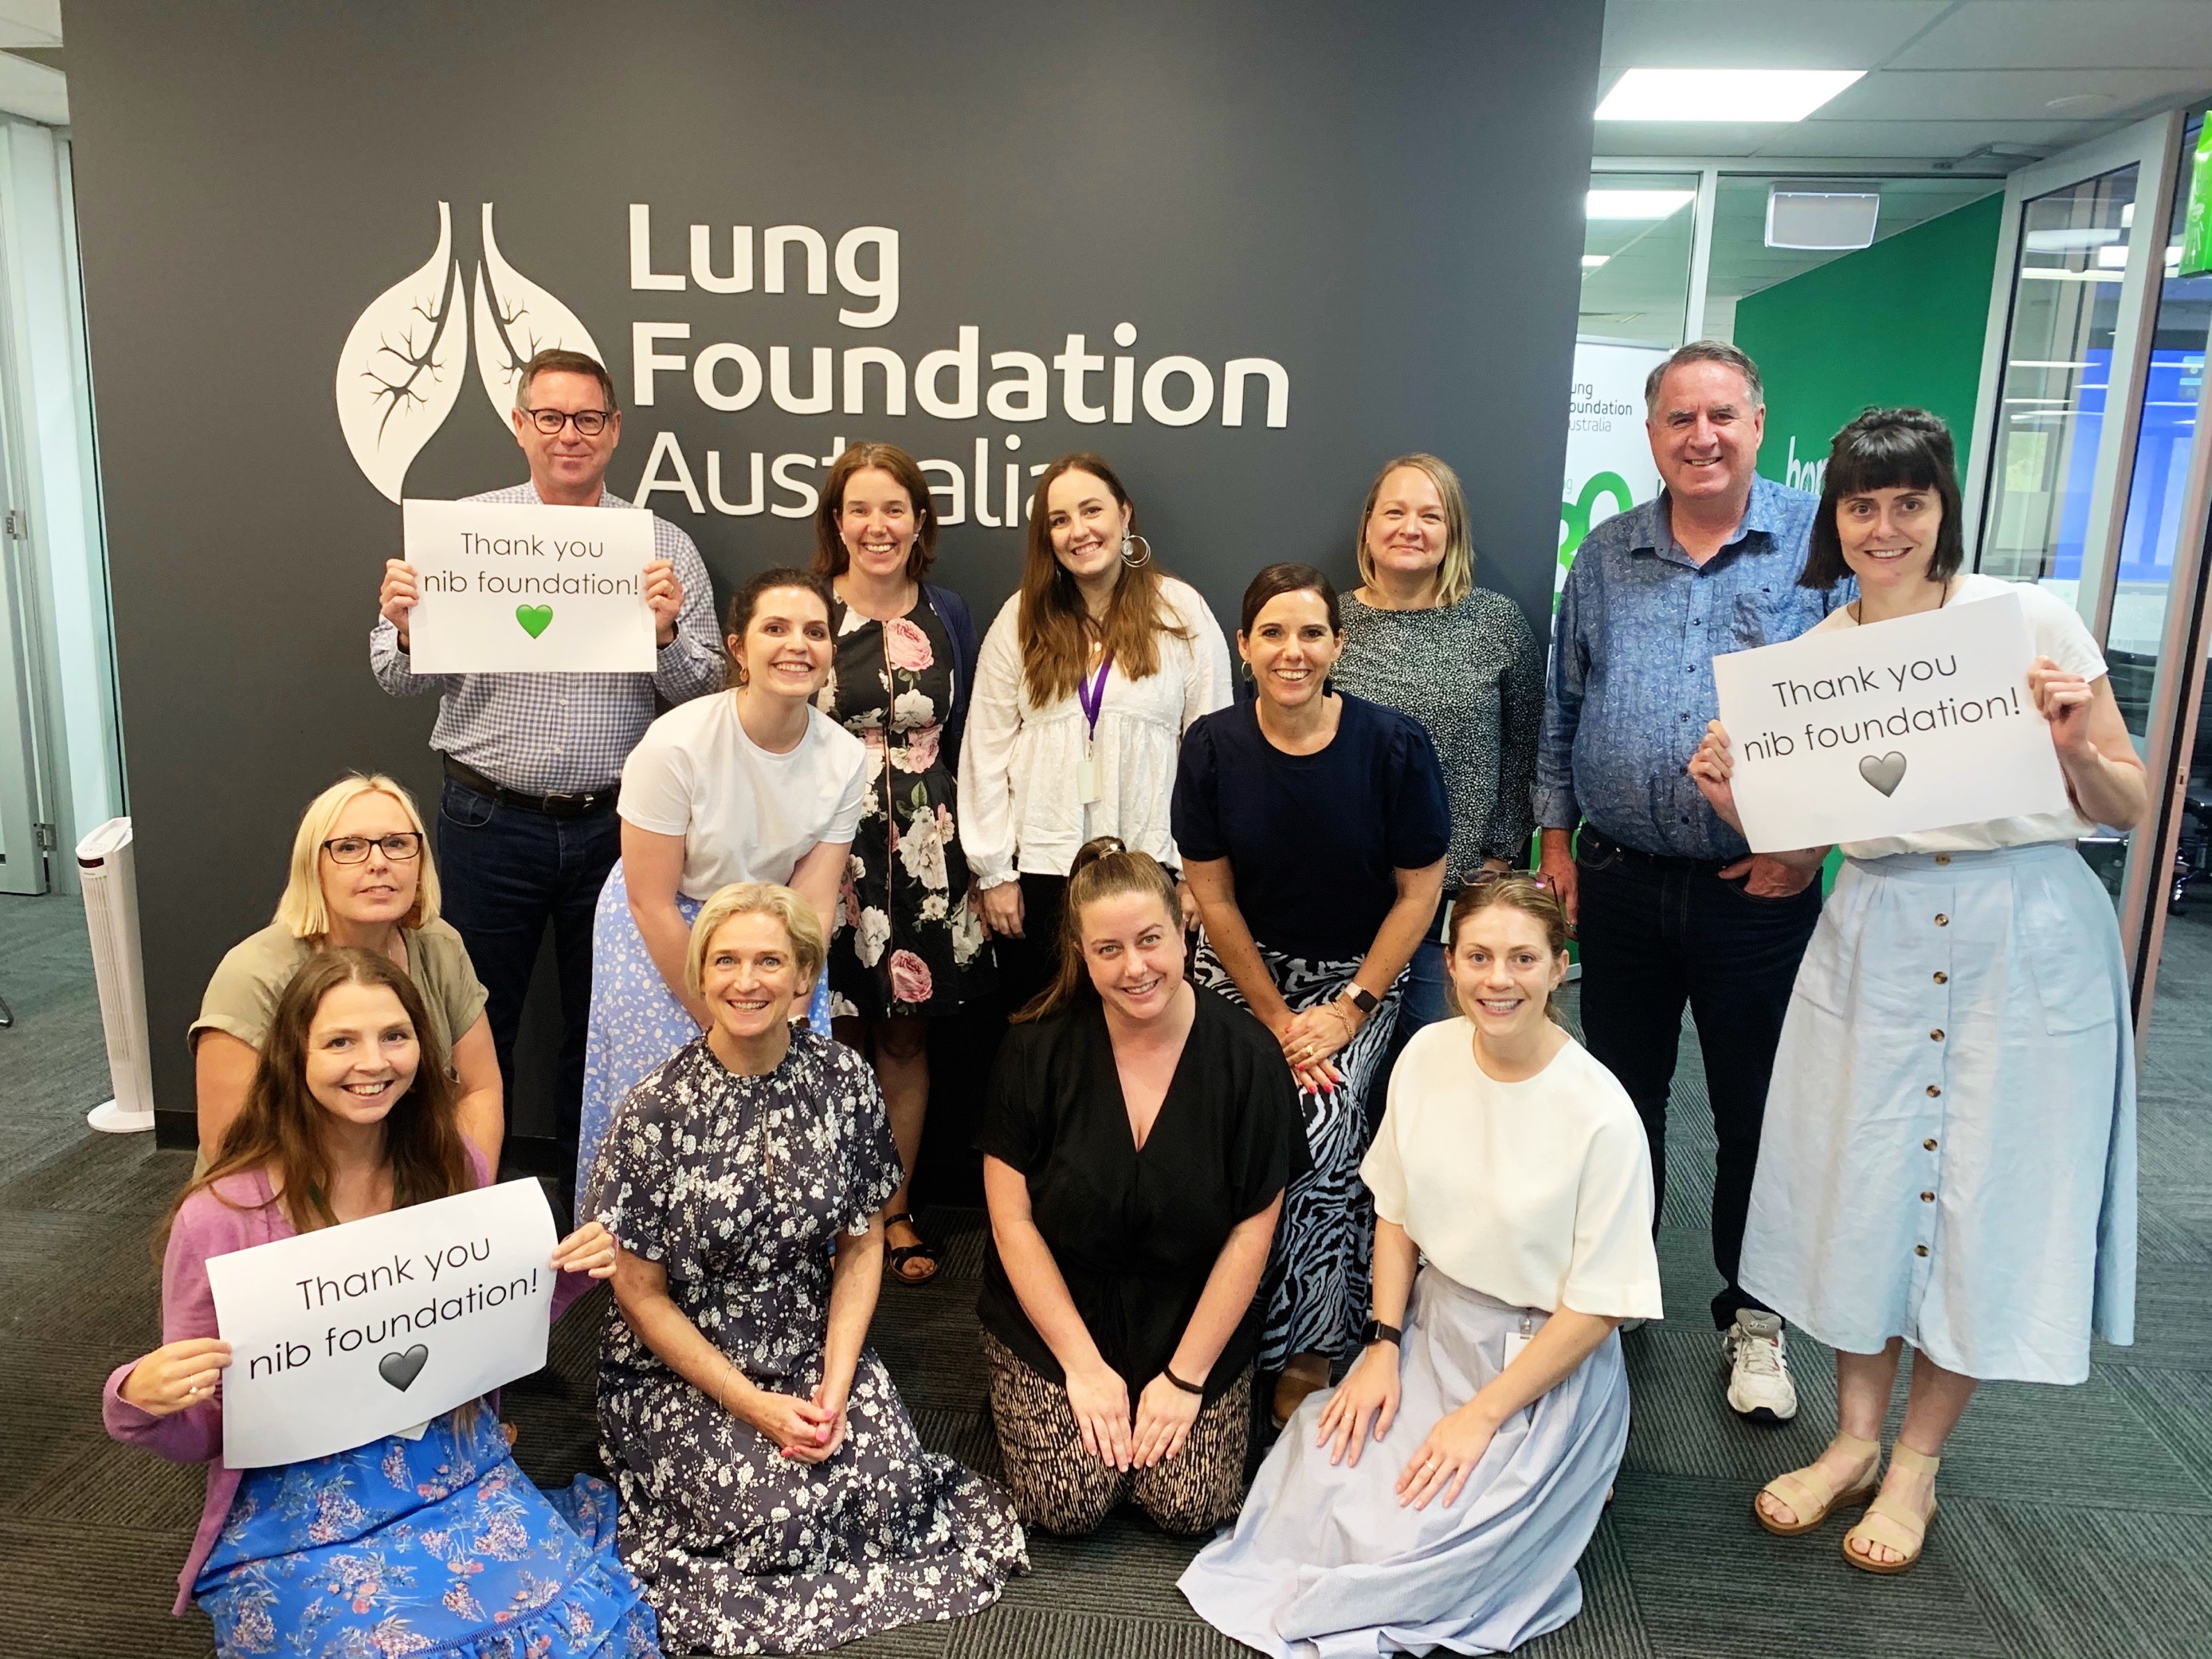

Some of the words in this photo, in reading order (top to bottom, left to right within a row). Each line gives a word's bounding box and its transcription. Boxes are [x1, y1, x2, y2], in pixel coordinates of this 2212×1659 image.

[629, 203, 899, 328] Lung
[632, 322, 1290, 428] Foundation
[633, 431, 1052, 529] Ausali
[424, 570, 468, 593] nib
[477, 571, 638, 596] foundation!
[460, 532, 545, 556] Thank
[554, 541, 603, 563] you
[1771, 665, 1881, 708] Thank
[1887, 654, 1958, 692] you
[1743, 731, 1794, 762] nib
[1804, 686, 2021, 751] foundation!
[296, 1254, 414, 1311] Thank
[424, 1237, 491, 1282] you
[249, 1340, 312, 1380] nib
[324, 1267, 539, 1358] foundation!
